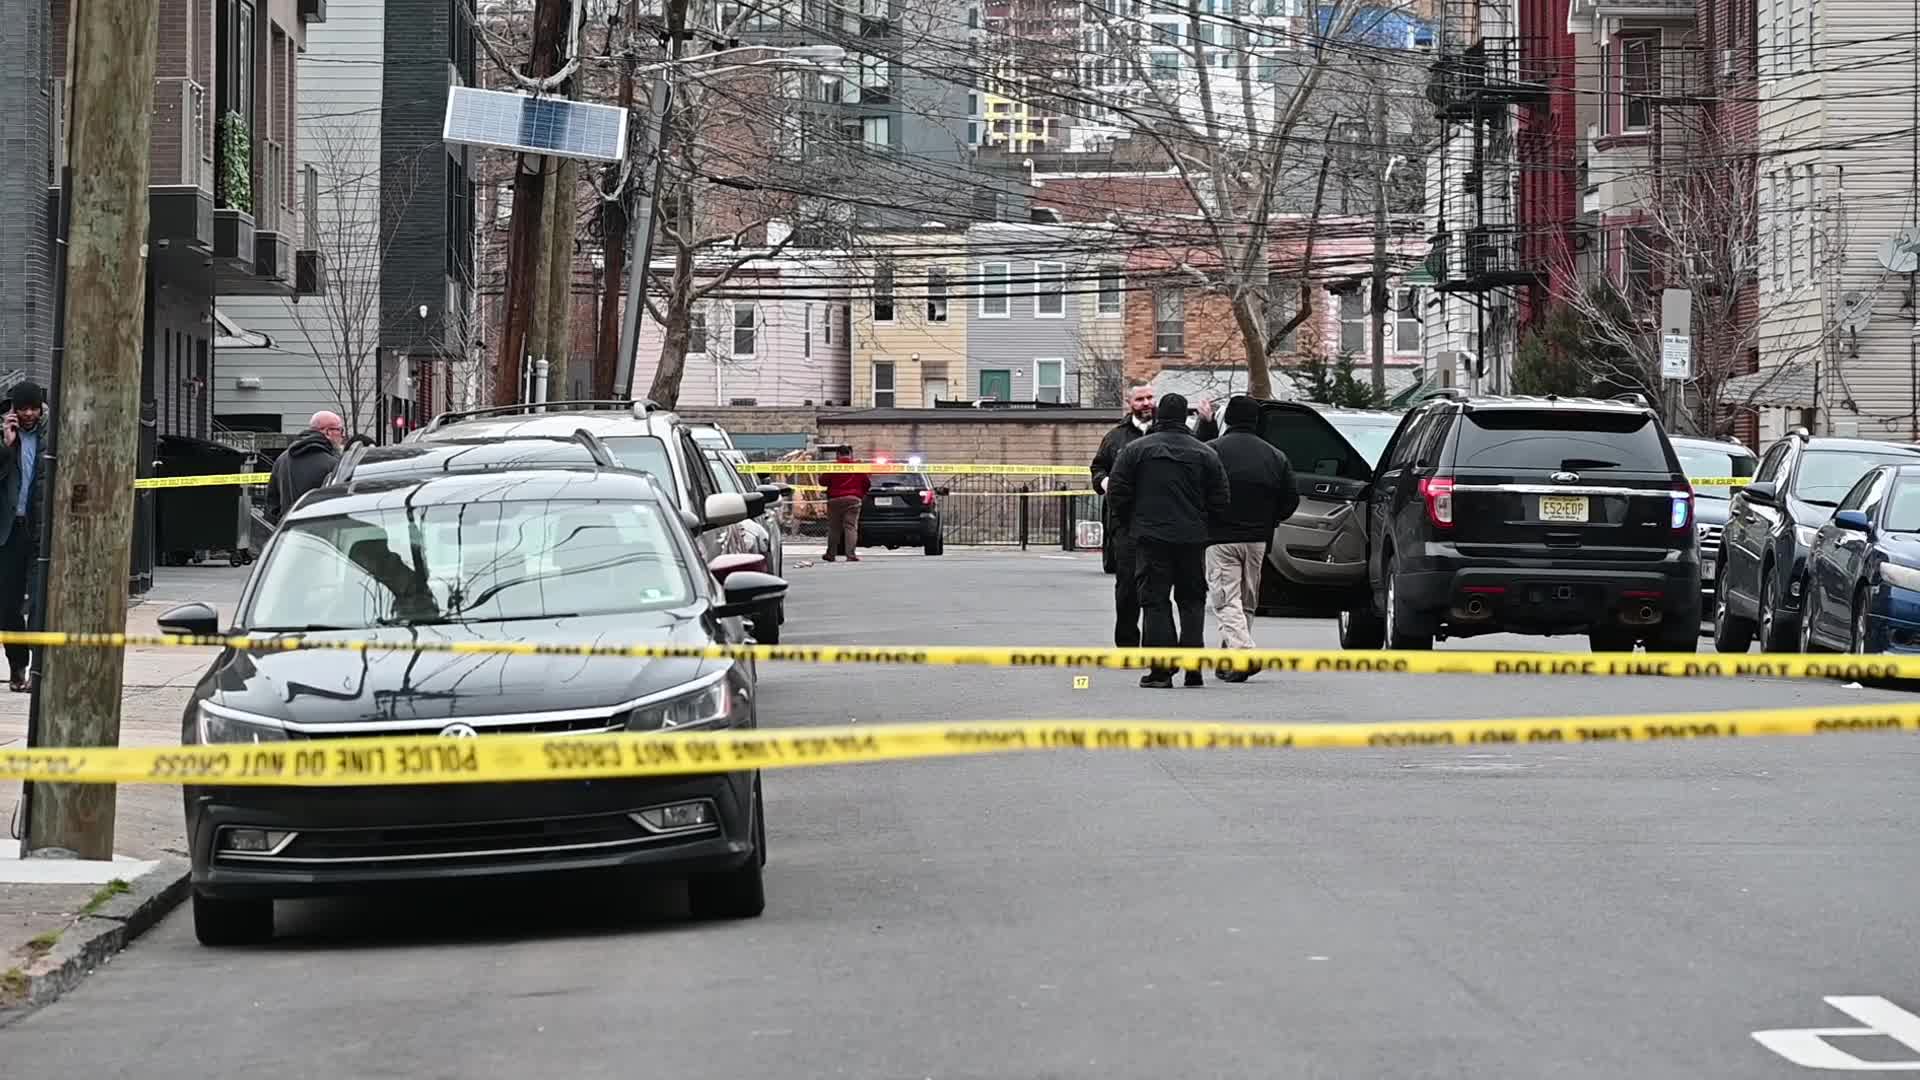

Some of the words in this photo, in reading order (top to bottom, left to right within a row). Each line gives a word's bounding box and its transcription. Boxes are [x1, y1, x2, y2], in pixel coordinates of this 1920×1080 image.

[237, 752, 285, 777] NOT
[294, 751, 326, 776] DO
[336, 748, 386, 775] LINE
[395, 745, 478, 775] POLICE
[542, 743, 622, 770] CROSS
[631, 744, 679, 767] NOT
